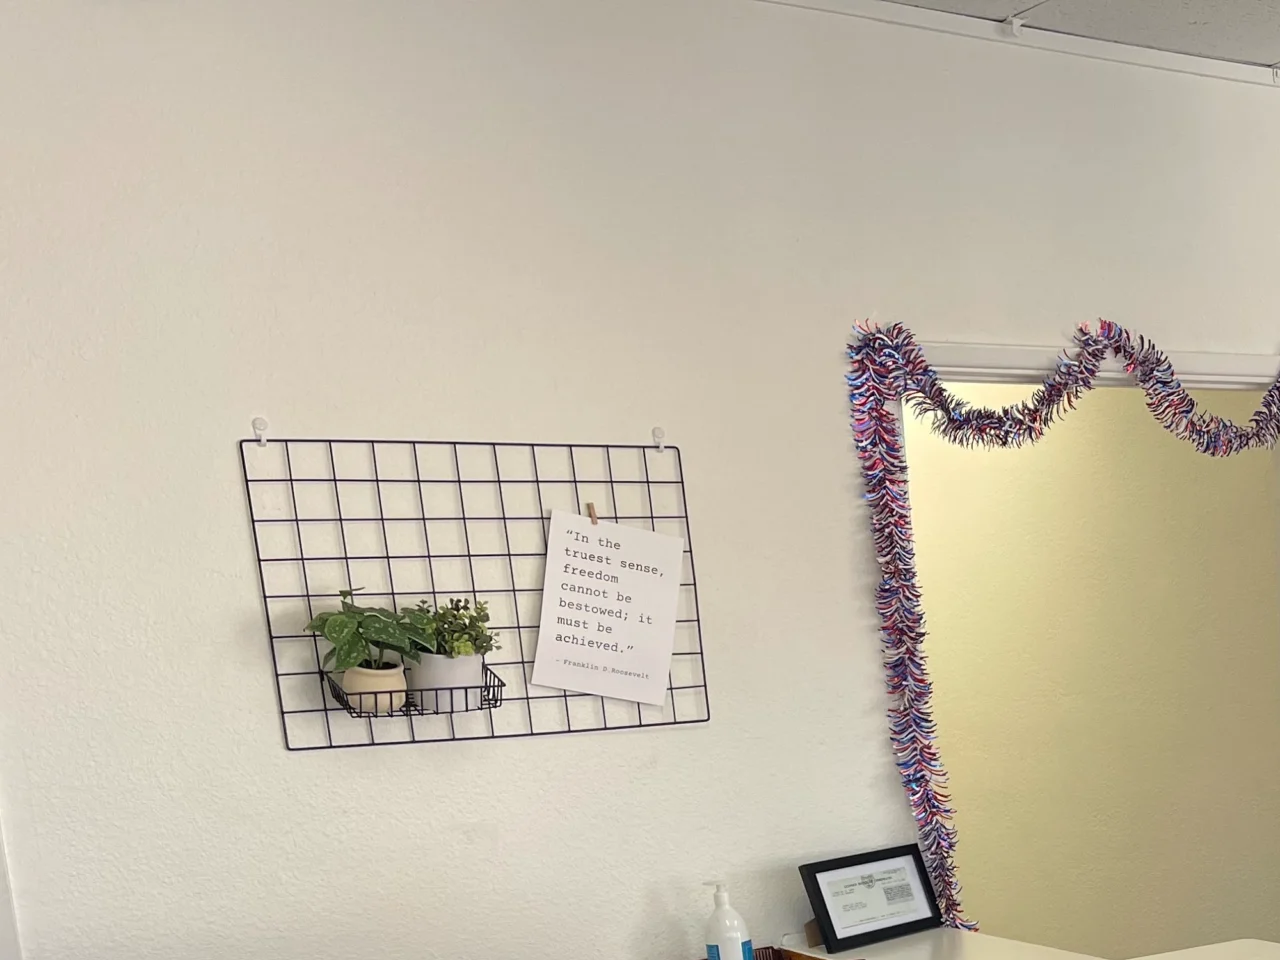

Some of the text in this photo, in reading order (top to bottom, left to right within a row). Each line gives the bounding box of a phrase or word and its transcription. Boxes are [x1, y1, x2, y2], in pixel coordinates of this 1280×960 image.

[598, 537, 621, 550] the
[564, 548, 664, 577] truest sense,
[563, 564, 619, 583] freedom
[561, 582, 632, 603] cannot be
[559, 598, 652, 624] bestowed; it
[557, 616, 612, 634] must be
[563, 659, 599, 671] Franklin
